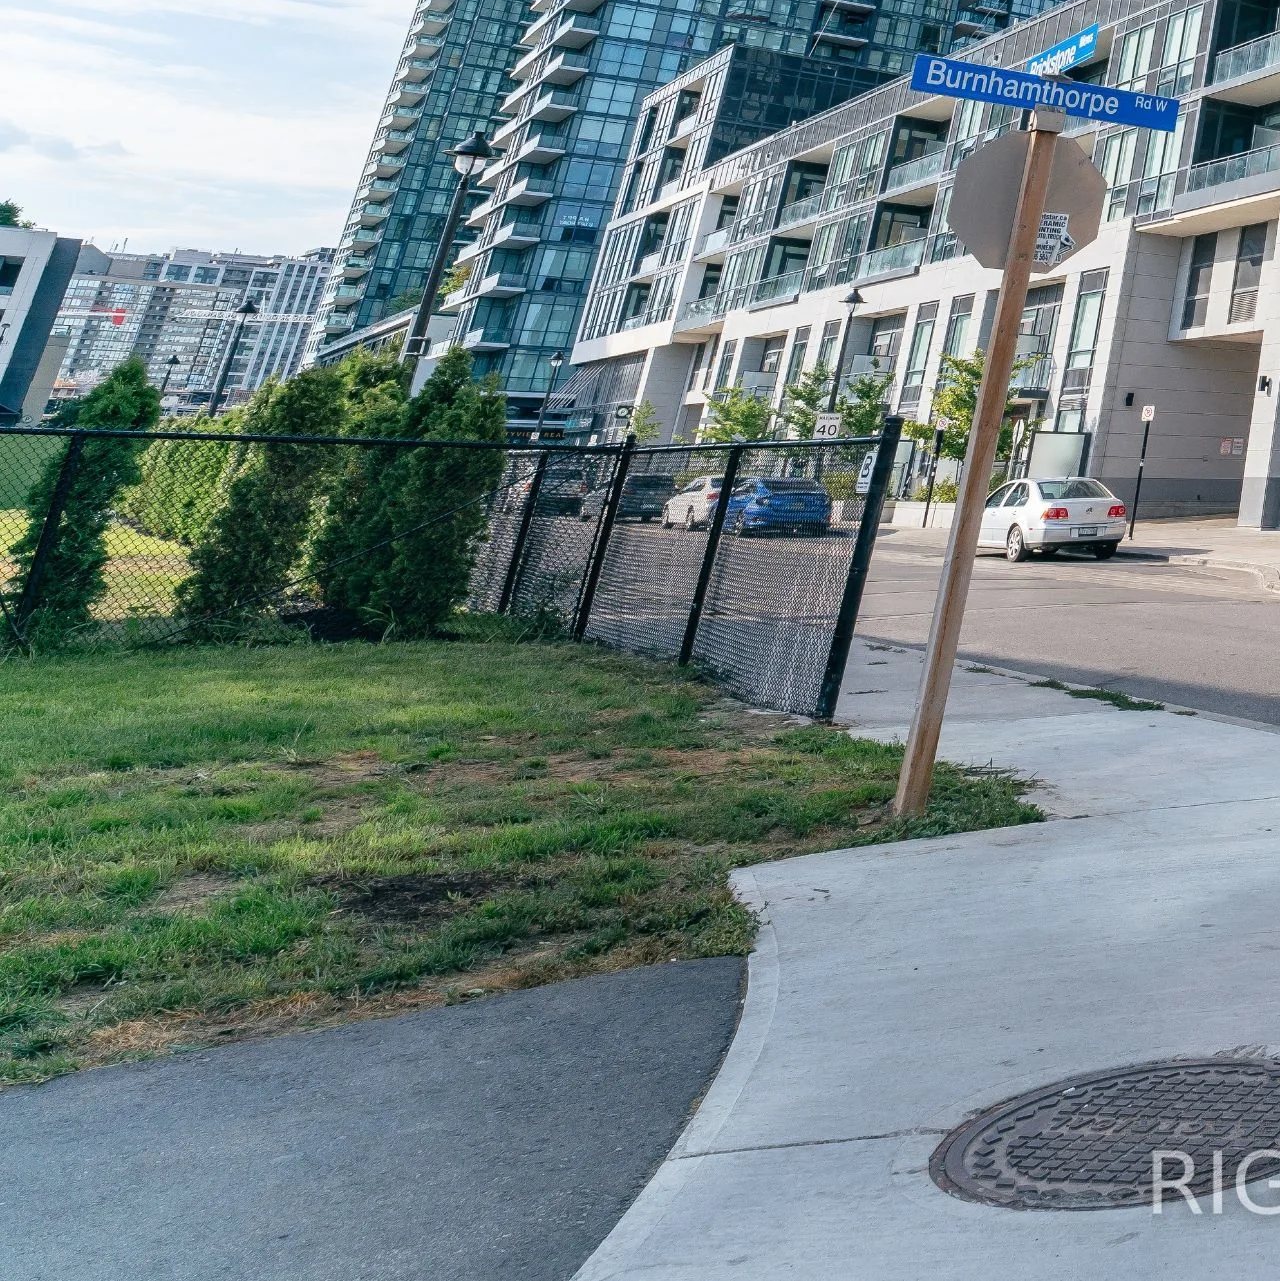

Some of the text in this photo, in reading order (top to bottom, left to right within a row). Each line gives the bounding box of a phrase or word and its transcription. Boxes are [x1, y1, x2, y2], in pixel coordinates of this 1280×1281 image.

[926, 60, 1168, 117] Burnhamthorpe Rd W
[816, 424, 837, 436] 40
